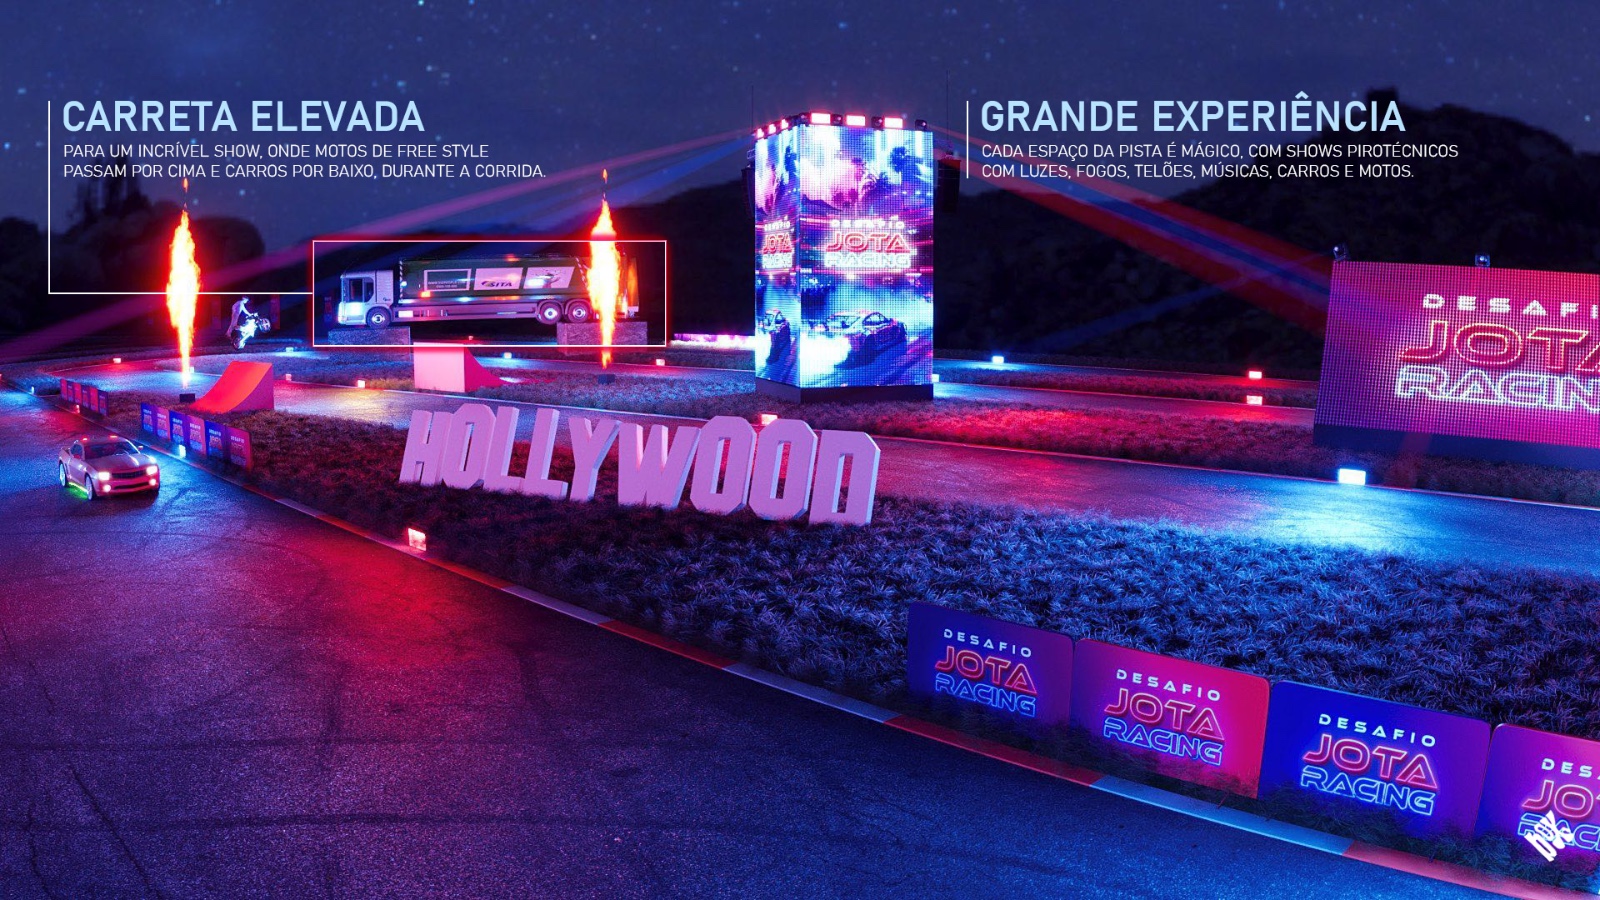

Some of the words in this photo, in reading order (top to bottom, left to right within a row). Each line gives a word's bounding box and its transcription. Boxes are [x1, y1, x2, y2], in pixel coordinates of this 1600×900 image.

[762, 232, 793, 254] JOTA
[824, 252, 912, 268] RACING
[826, 231, 911, 254] JOTA
[399, 403, 882, 525] HOLLYWOOD
[943, 628, 1032, 658] DESAFIO
[935, 645, 1038, 696] JOTA
[1116, 669, 1221, 701] DESAFIO
[935, 672, 1036, 718] RACING
[1104, 688, 1225, 741] JOTA
[1103, 717, 1223, 766] RACING
[1319, 713, 1436, 747] DESAFIO
[1302, 733, 1438, 790] JOTA
[1541, 758, 1600, 780] DES
[1300, 765, 1437, 816] RACING
[1521, 779, 1600, 818] JO
